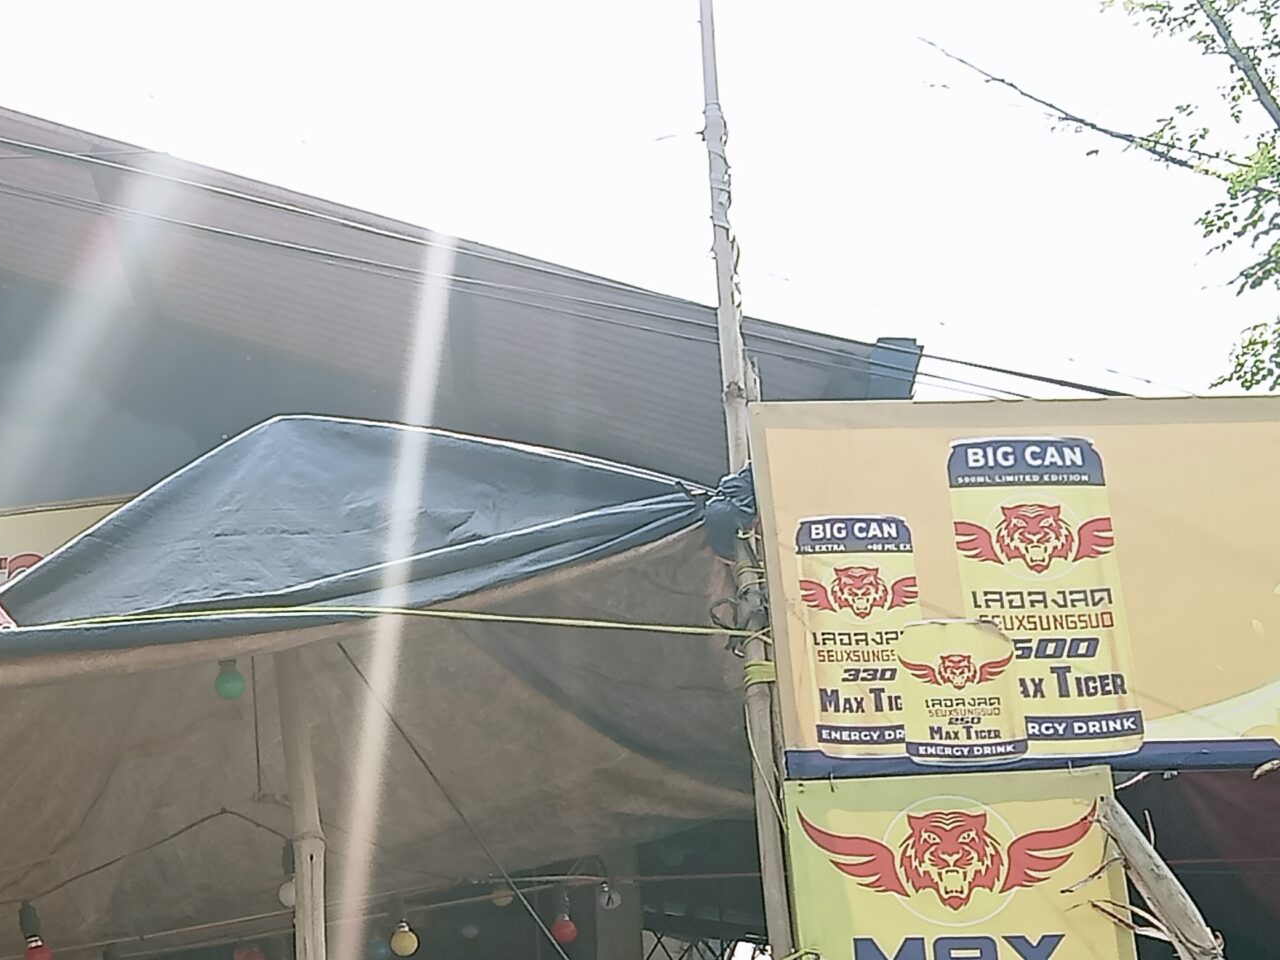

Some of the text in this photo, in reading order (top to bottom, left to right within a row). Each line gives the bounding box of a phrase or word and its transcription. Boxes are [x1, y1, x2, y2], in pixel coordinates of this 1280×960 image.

[967, 445, 1084, 467] BIG CAN
[995, 474, 1040, 483] LIMITED
[1043, 473, 1089, 482] EDITION
[810, 522, 897, 539] BIG CAN
[815, 544, 845, 552] EXTRA
[1011, 638, 1100, 660] 500
[841, 668, 897, 682] 330
[1019, 678, 1046, 698] AX
[948, 717, 981, 725] 250
[1073, 717, 1138, 734] DRINK
[822, 730, 881, 742] ENERGY
[918, 744, 1015, 756] ENERGY DRINK
